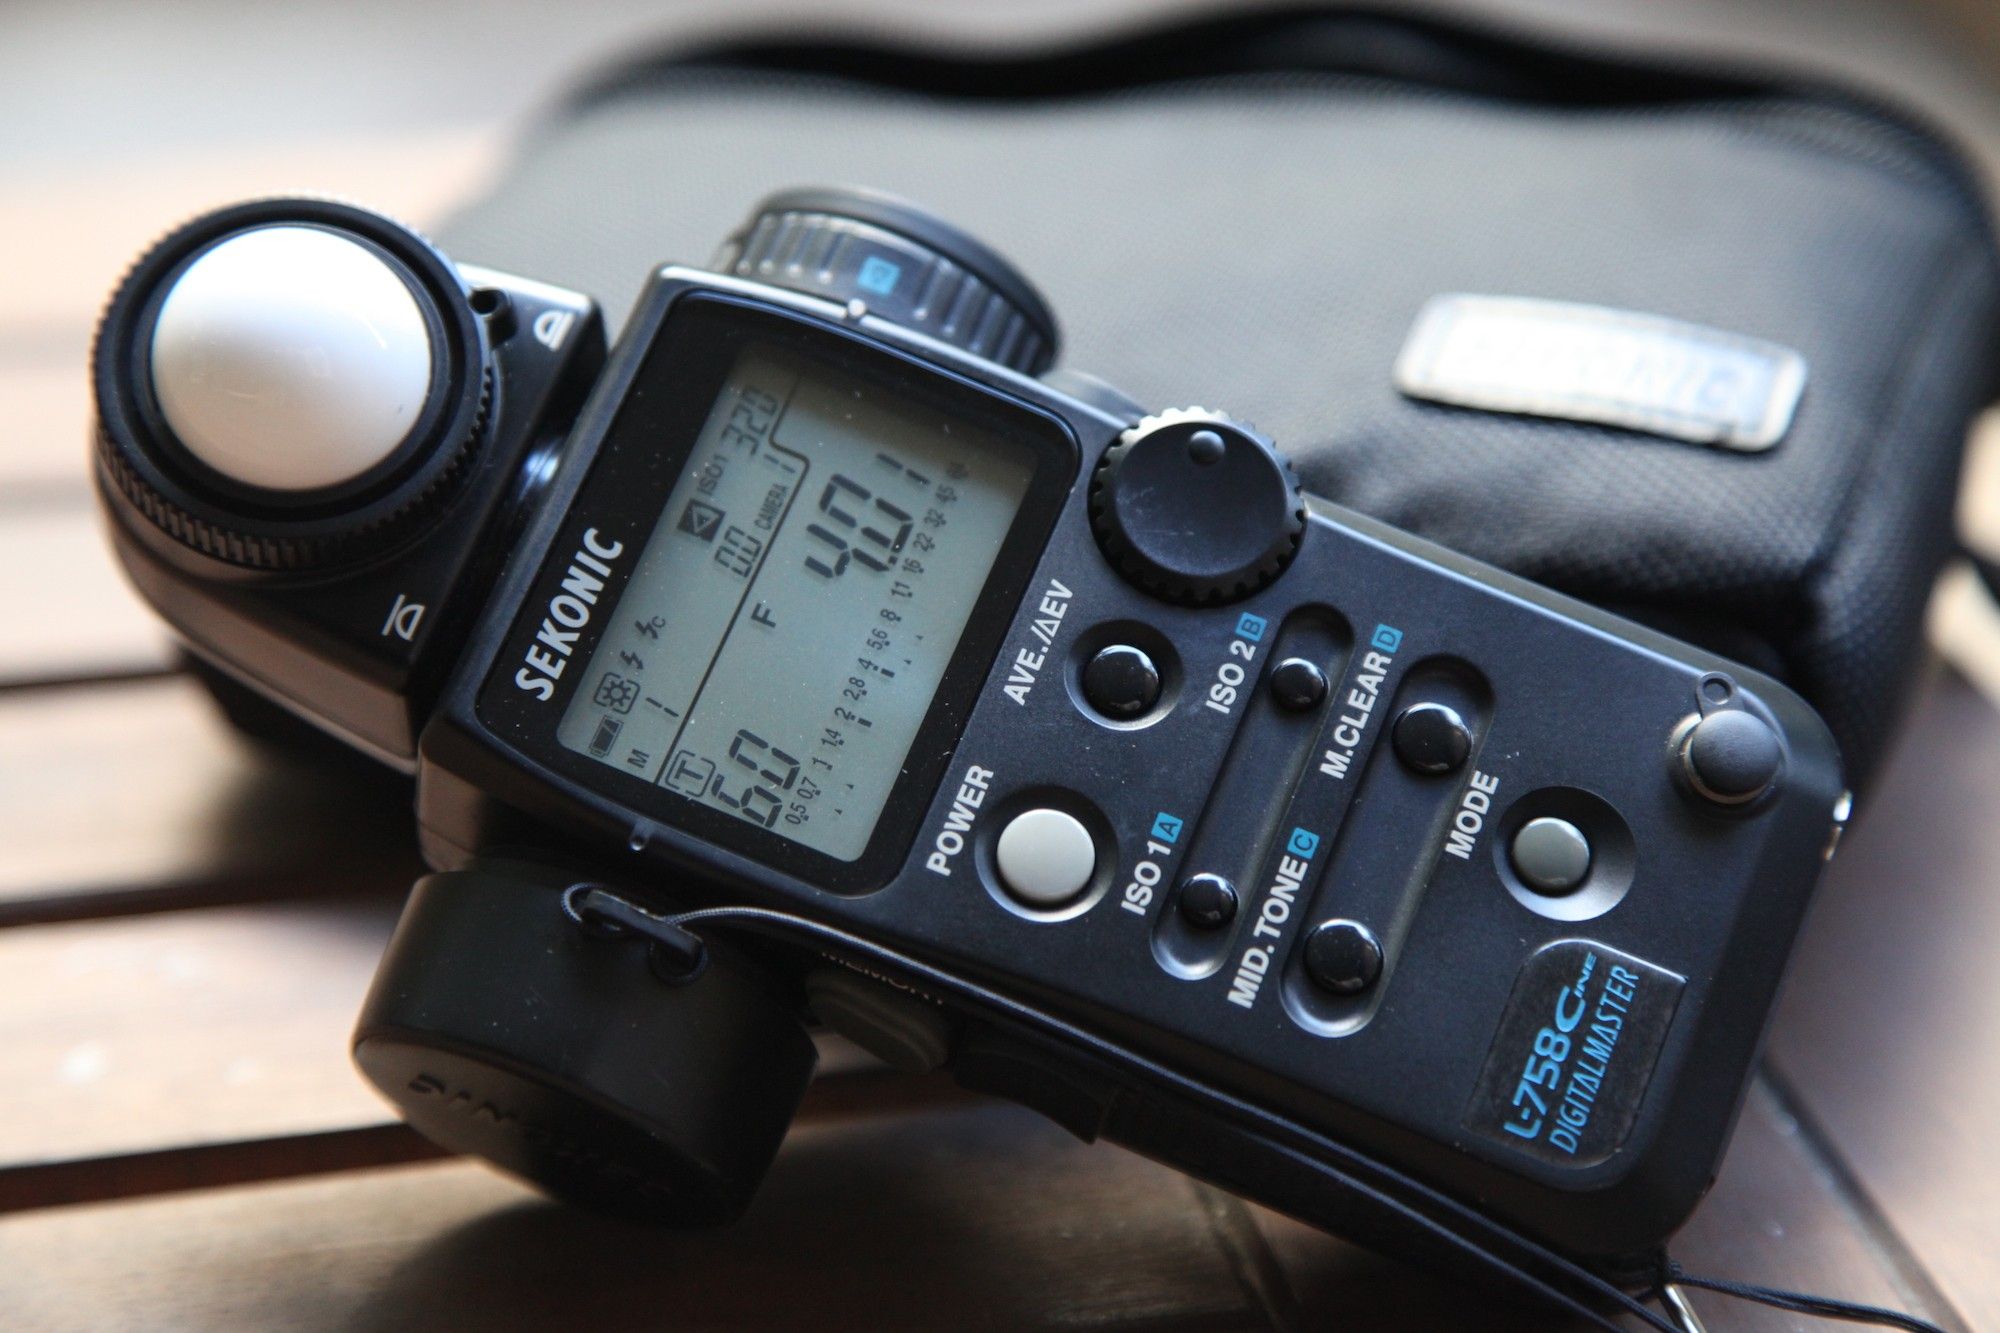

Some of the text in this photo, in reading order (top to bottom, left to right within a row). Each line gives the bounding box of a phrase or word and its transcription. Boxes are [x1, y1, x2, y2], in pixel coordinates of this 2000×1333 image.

[698, 386, 778, 495] ISO1 320
[754, 483, 788, 530] CAMERA
[515, 528, 623, 701] SEKONIC
[750, 603, 776, 627] F
[835, 707, 851, 721] 2
[858, 657, 874, 670] 4
[881, 608, 897, 621] 8
[902, 558, 921, 573] 16
[913, 533, 933, 552] 22
[924, 509, 944, 528] 32
[1206, 663, 1245, 714] ISO
[1231, 640, 1256, 661] 2
[1320, 651, 1392, 780] M.CLEAR
[627, 749, 649, 768] M
[711, 729, 800, 828] 60
[926, 765, 994, 876] POWER
[1445, 770, 1499, 860] MODE
[1121, 861, 1162, 916] ISO
[1148, 840, 1171, 856] 1
[1227, 943, 1275, 1009] MID.
[1255, 856, 1308, 944] TONE
[1549, 964, 1640, 1154] DIGITALMASTER
